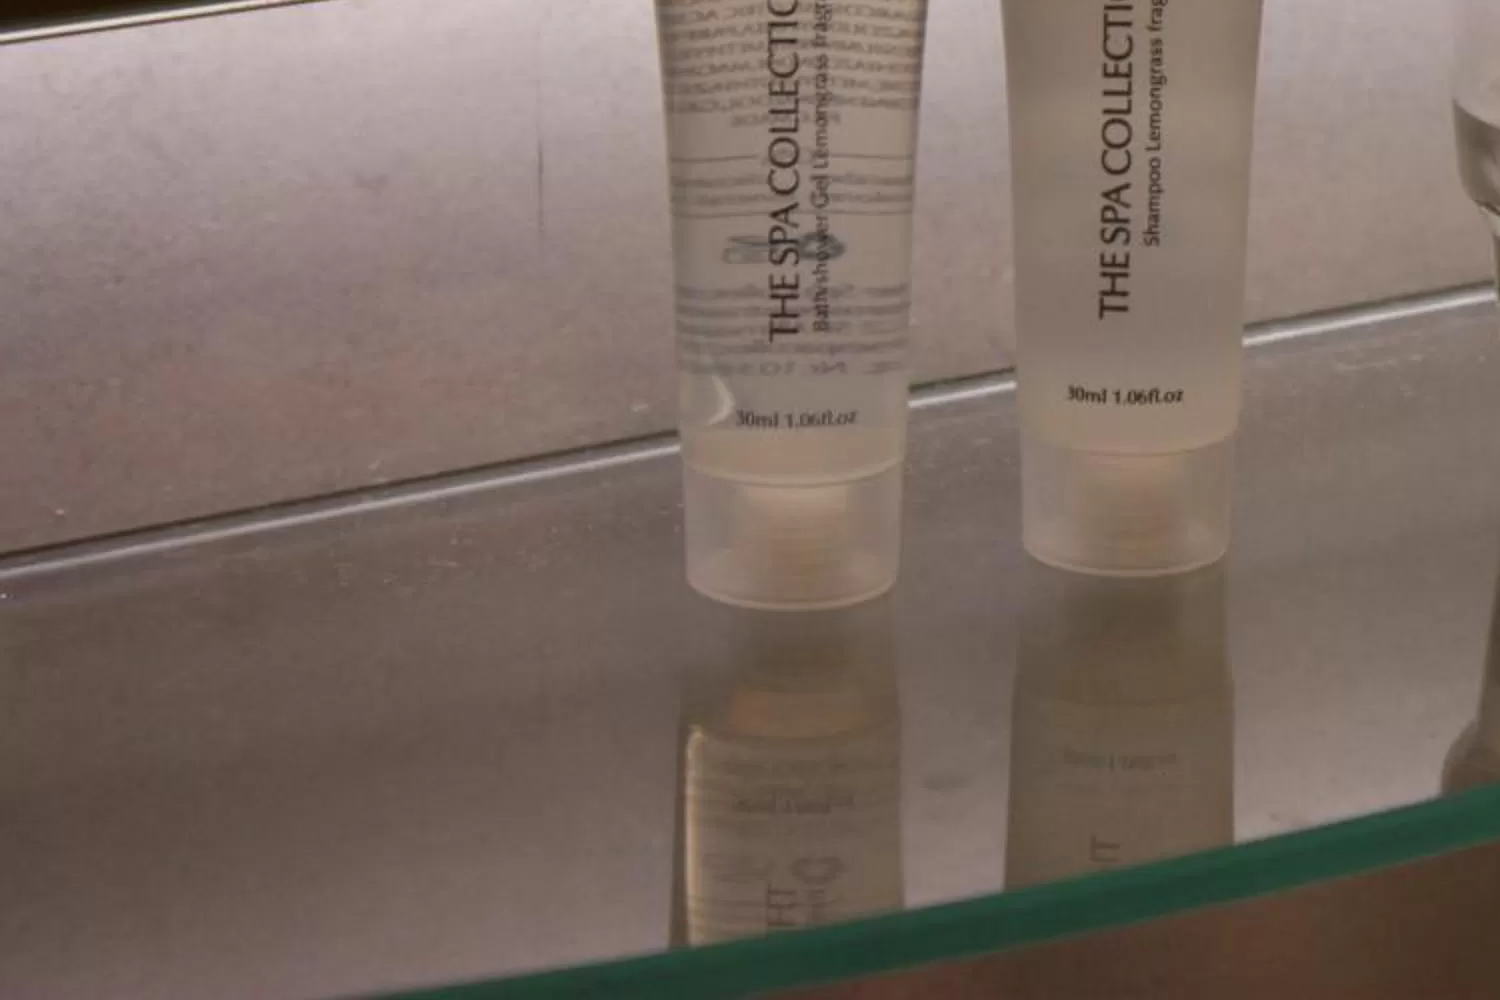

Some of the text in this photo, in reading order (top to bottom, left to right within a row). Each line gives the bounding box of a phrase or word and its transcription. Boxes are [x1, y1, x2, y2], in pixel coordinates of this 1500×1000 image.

[811, 53, 833, 170] Lemongrass
[1146, 36, 1167, 152] Lemongrass
[811, 175, 830, 210] Gel
[1101, 182, 1132, 244] SPA
[1143, 156, 1165, 248] Shampoo
[768, 202, 800, 266] SPA
[768, 273, 800, 343] THE
[1099, 252, 1131, 320] THE
[1068, 384, 1107, 404] 30ml
